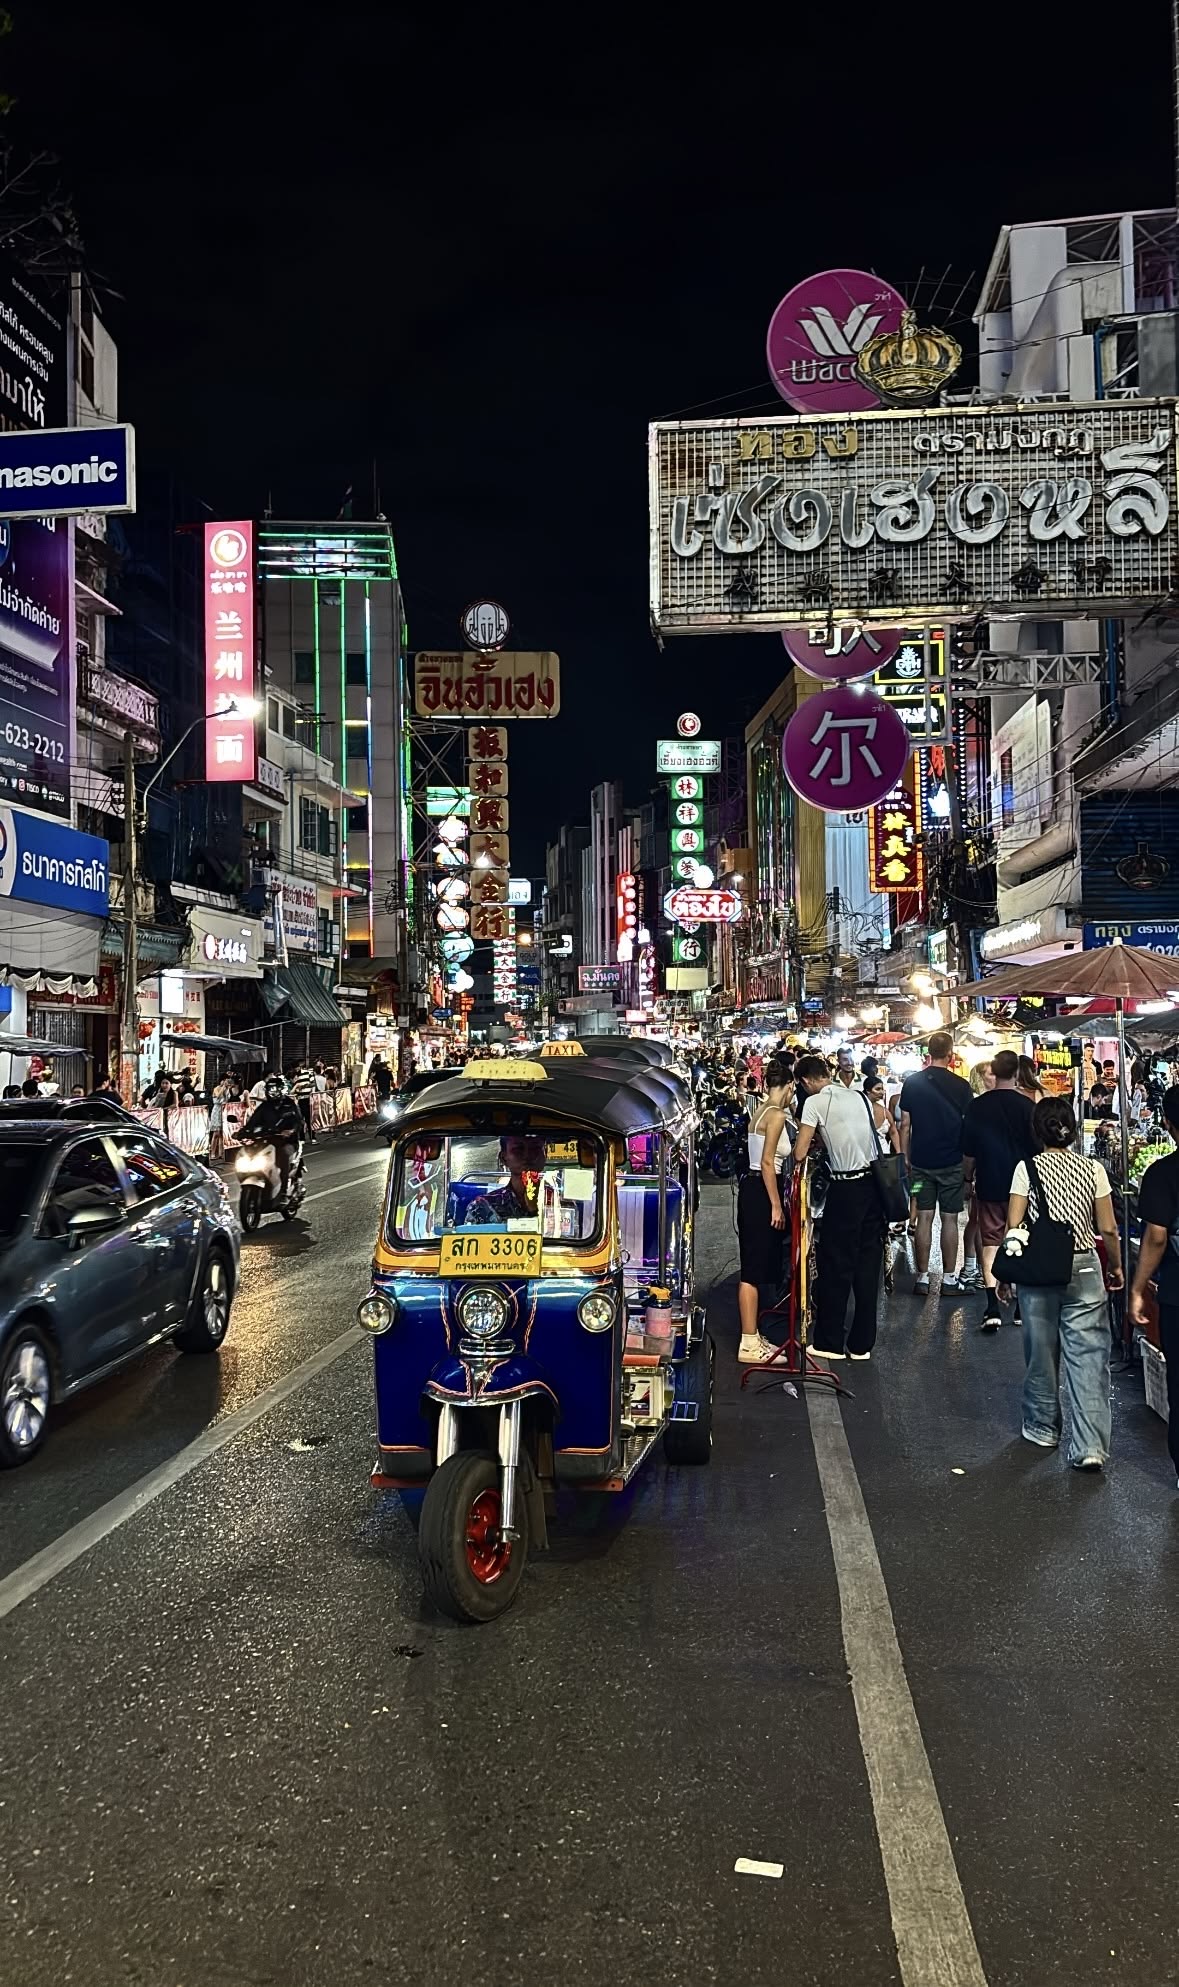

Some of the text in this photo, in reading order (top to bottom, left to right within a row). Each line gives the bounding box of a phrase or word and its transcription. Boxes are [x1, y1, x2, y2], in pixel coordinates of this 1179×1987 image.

[792, 359, 857, 384] Wac
[737, 427, 859, 460] ทอง
[22, 852, 105, 893] ธนาคารทิสโก้
[1095, 925, 1132, 938] ทอง
[546, 1045, 576, 1056] TAXI
[452, 1237, 537, 1257] สก 3306
[456, 1262, 524, 1272] กรุงเทพมหานคร
